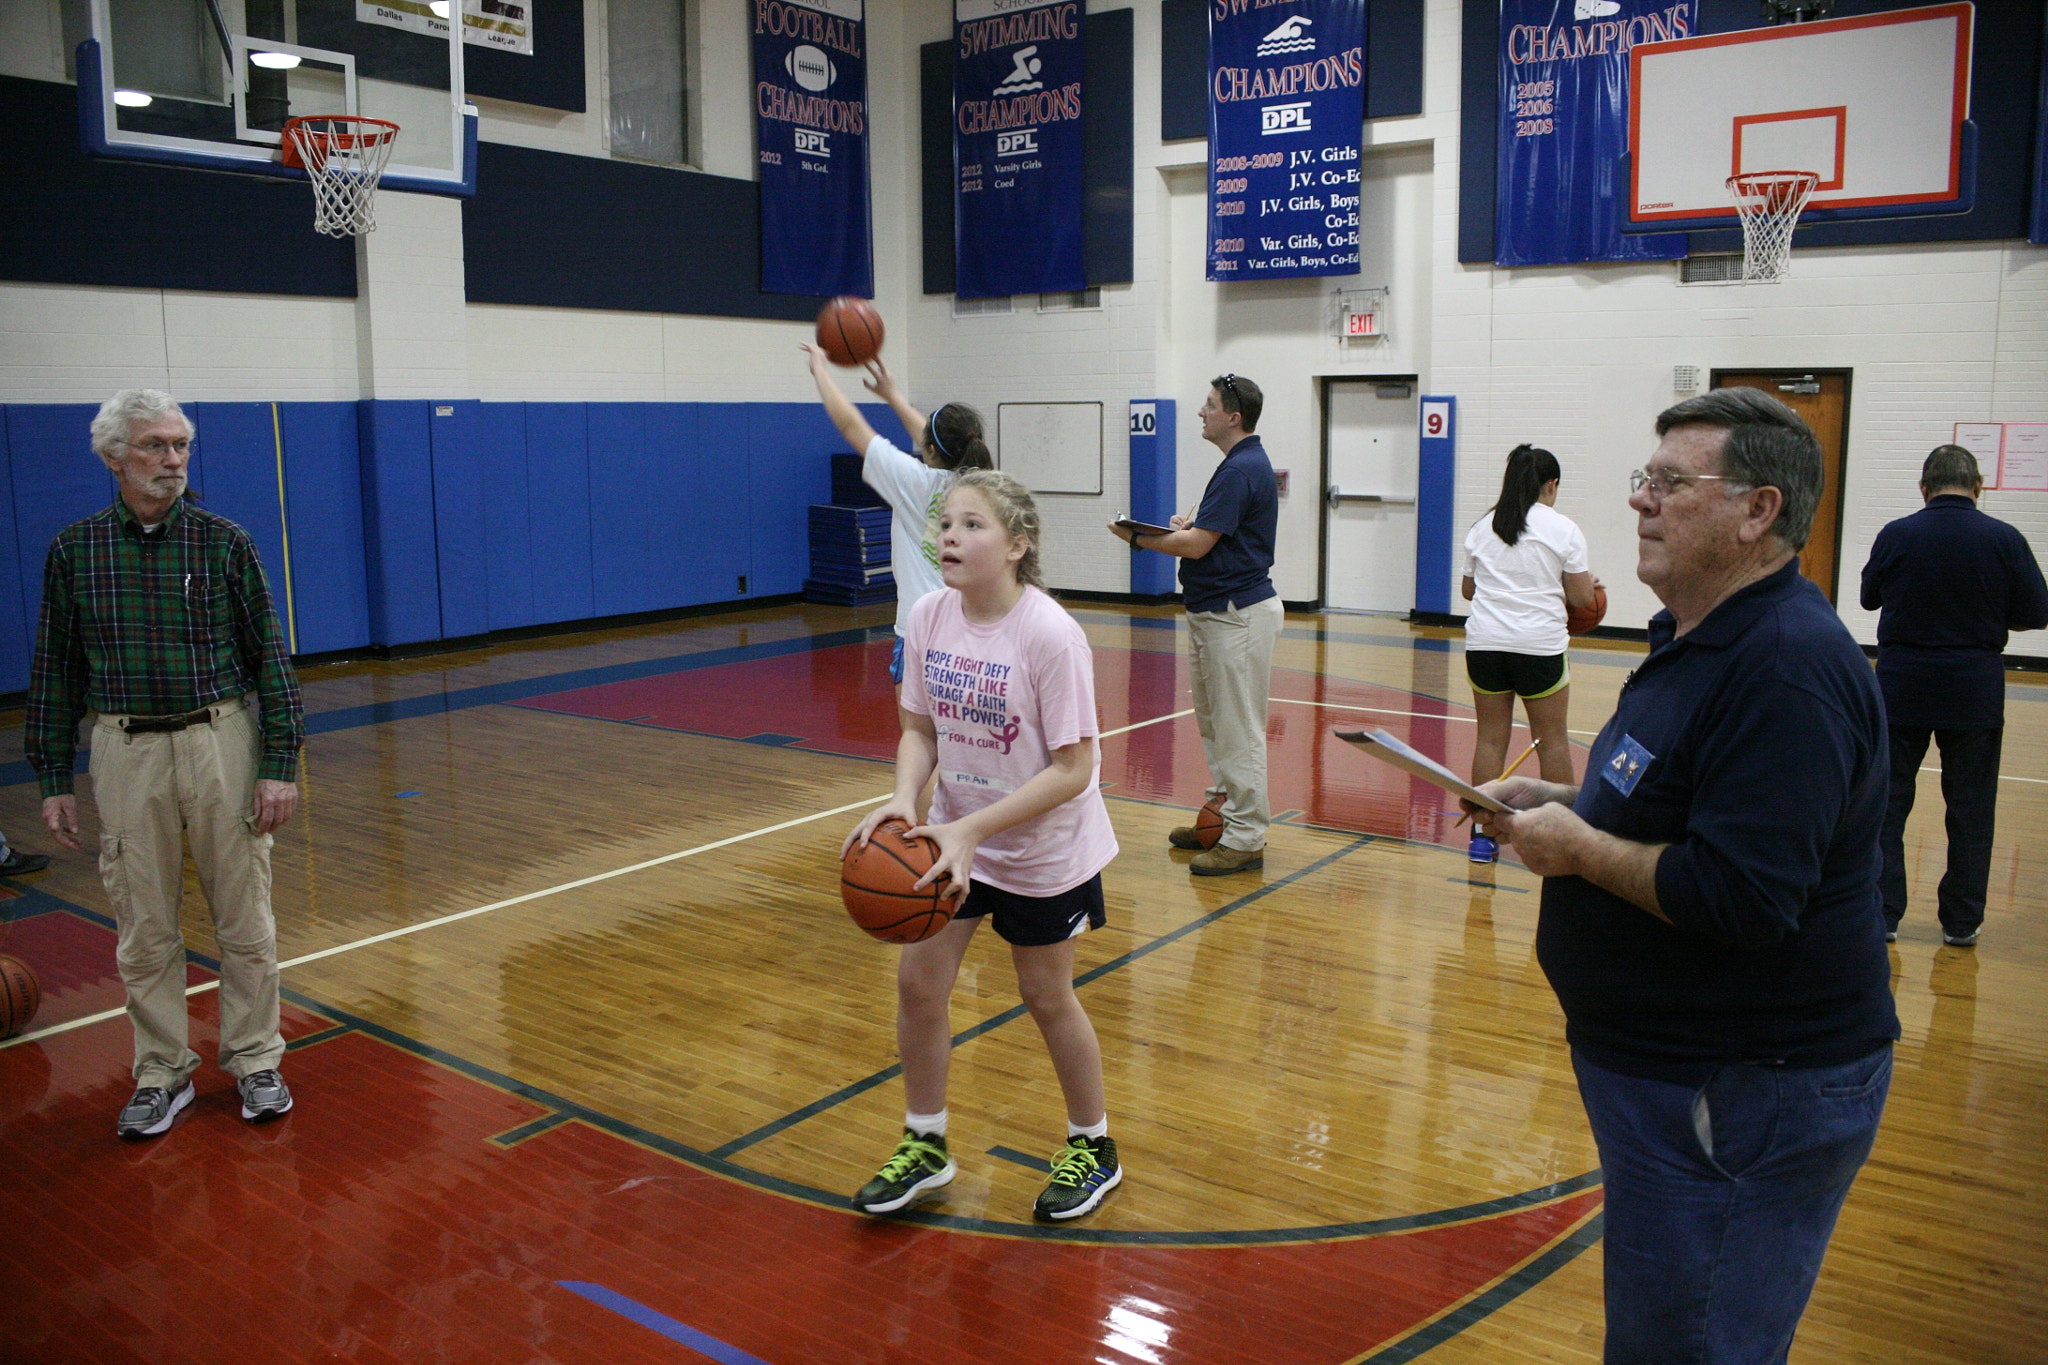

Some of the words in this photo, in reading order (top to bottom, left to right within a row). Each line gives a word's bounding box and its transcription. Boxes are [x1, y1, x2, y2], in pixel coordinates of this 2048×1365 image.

[377, 8, 403, 22] Dallas
[756, 0, 860, 58] FOOTBALL
[961, 4, 1078, 59] SWIMMING
[1508, 4, 1689, 65] CHAMPIONS
[1215, 47, 1362, 103] CHAMPIONS
[1517, 80, 1554, 98] 2005
[757, 81, 863, 136] CHAMPIONS
[959, 83, 1081, 134] CHAMPIONS
[1516, 99, 1553, 116] 2006
[1262, 108, 1311, 129] DPL
[1516, 118, 1553, 136] 2008
[795, 132, 831, 154] DPL
[997, 133, 1038, 152] DPL
[760, 151, 782, 165] 2012
[1289, 150, 1316, 169] J.V.
[1321, 145, 1357, 162] Girls
[961, 164, 983, 177] 2012
[994, 163, 1020, 174] Varsity
[1022, 160, 1042, 170] Girls
[961, 179, 983, 192] 2012
[994, 178, 1014, 189] Coed
[1216, 177, 1248, 194] 2009
[1289, 172, 1316, 191] J.V.
[1215, 201, 1246, 216] 2010
[1260, 199, 1284, 217] J.V.
[1288, 195, 1325, 211] Girls,
[1215, 238, 1246, 252] 2010
[1260, 237, 1284, 251] Var.
[1288, 234, 1322, 250] Girls,
[1215, 260, 1238, 271] 2011
[1248, 259, 1268, 269] Var.
[1270, 257, 1299, 269] Girls,
[1301, 255, 1329, 269] Boys,
[1330, 253, 1359, 265] Co-Ed
[1350, 314, 1374, 334] EXIT
[1131, 413, 1156, 432] 10
[1427, 413, 1443, 435] 9
[925, 649, 952, 667] HOPE
[954, 656, 984, 675] FIGHT
[984, 663, 1011, 680] DEFY
[925, 665, 976, 690] STRENGTH
[978, 678, 1008, 697] LIKE
[967, 692, 975, 707] A
[977, 694, 1006, 713] FAITH
[962, 706, 1006, 728] POWER
[949, 733, 966, 744] FOR
[968, 737, 975, 747] A
[976, 739, 1001, 750] CURE
